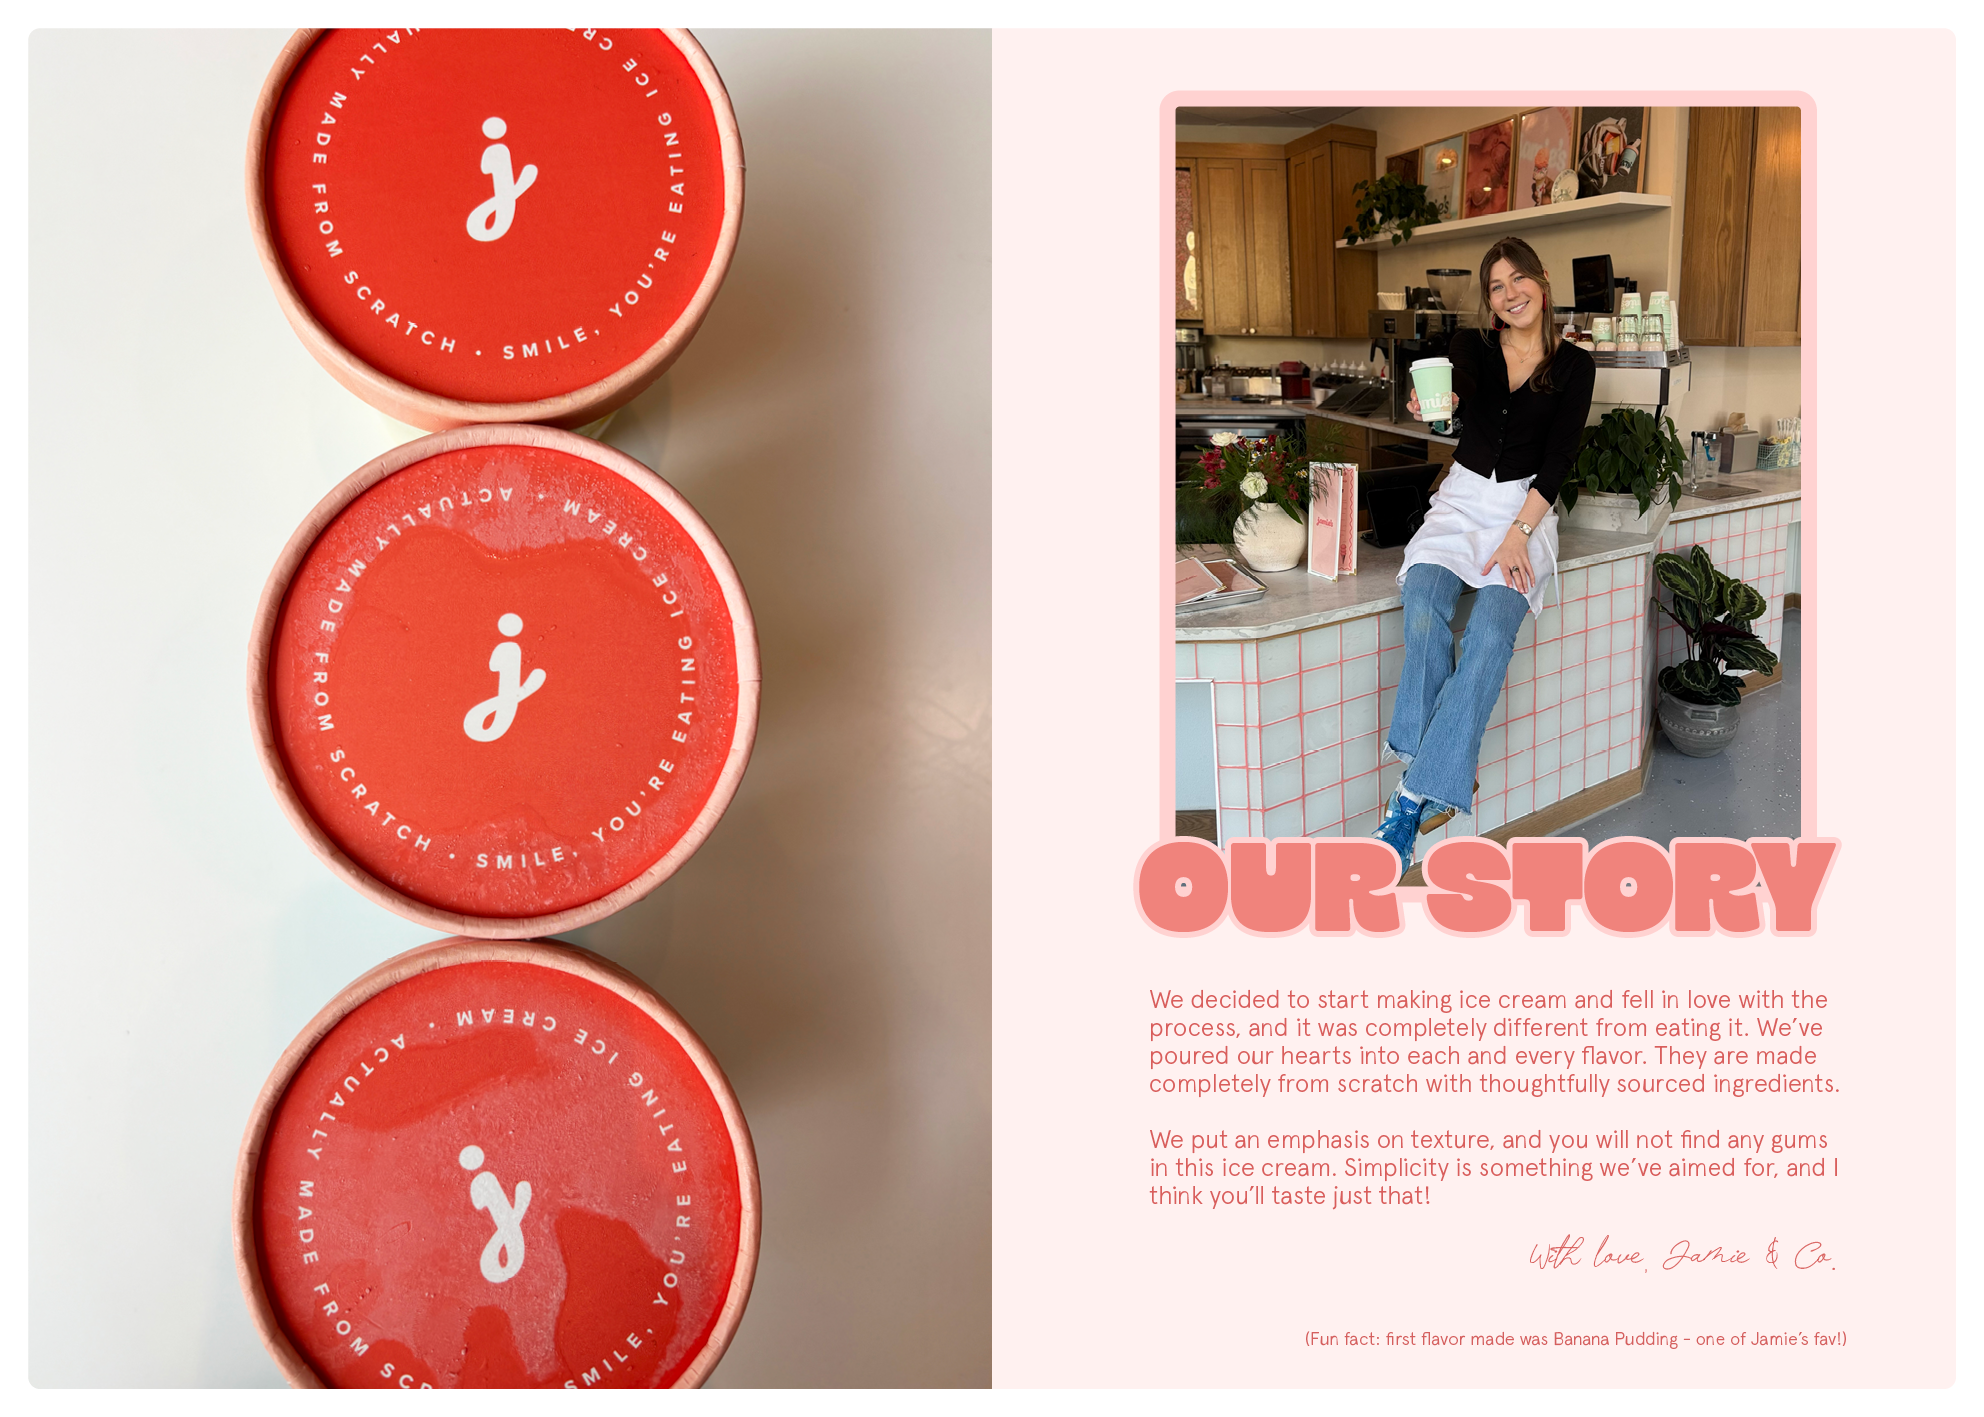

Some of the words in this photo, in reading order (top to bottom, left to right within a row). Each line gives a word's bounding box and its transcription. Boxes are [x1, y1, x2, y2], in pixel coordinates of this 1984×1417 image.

[622, 58, 658, 97] ICE
[312, 92, 347, 164] MADE
[657, 112, 684, 213] EATING
[311, 184, 343, 257] FROM
[608, 231, 676, 317] YOU'RE
[343, 271, 455, 353] SCRATCH
[502, 326, 601, 360] SMILE,
[375, 488, 512, 551] ACTUALLY
[562, 499, 648, 562] CREAM
[319, 559, 366, 632] MADE
[651, 573, 683, 617] ICE
[312, 652, 334, 731] FROM
[671, 636, 695, 743] EATING
[329, 750, 431, 851] SCRATCH
[591, 759, 674, 842] YOU'RE
[475, 847, 579, 869] SMILE,
[456, 1009, 556, 1031] CREAM
[573, 1029, 618, 1064] ICE
[306, 1034, 405, 1159] ACTUALLY
[628, 1072, 687, 1173] EATING
[298, 1181, 318, 1264] MADE
[652, 1195, 690, 1305] YOU'RE
[313, 1283, 369, 1356] FROM
